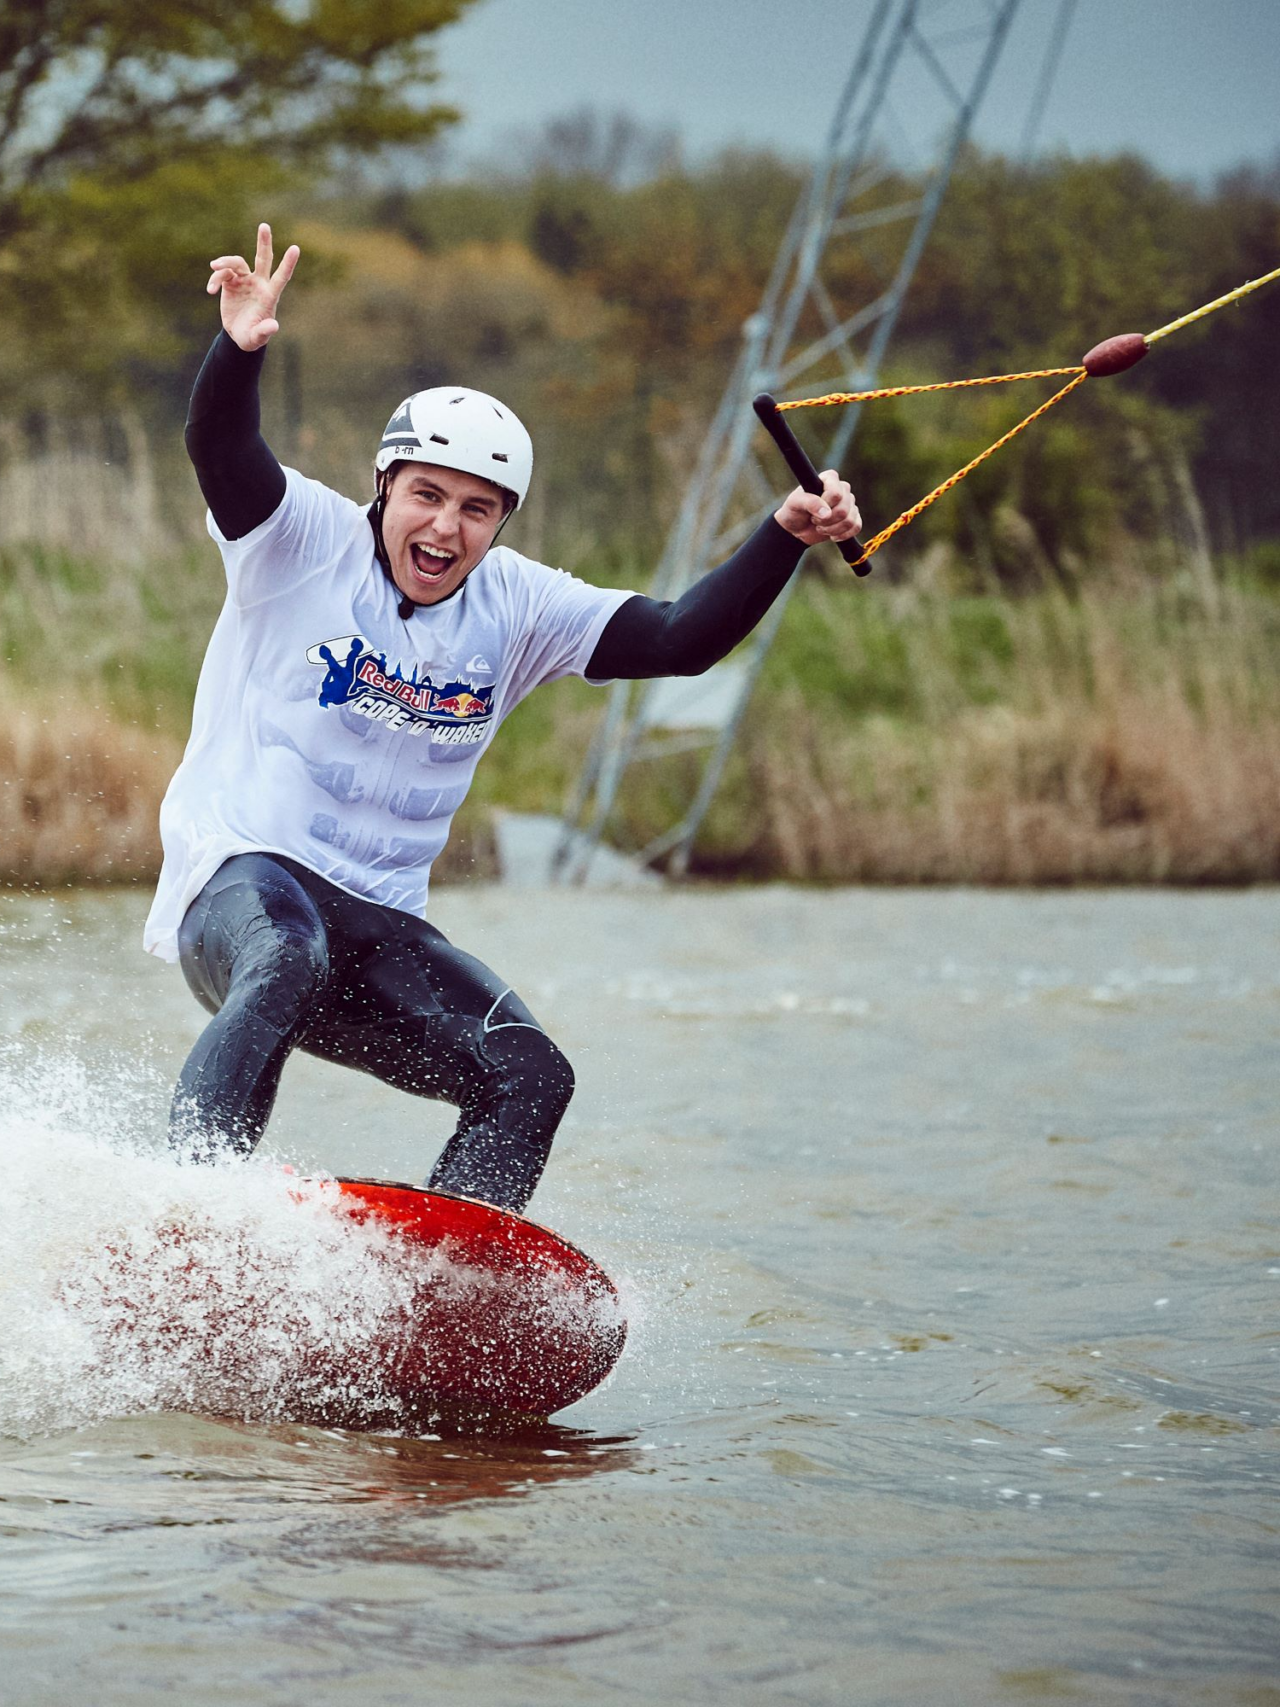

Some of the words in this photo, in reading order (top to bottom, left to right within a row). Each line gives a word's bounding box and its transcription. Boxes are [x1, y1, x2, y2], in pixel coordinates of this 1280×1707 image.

[358, 660, 402, 694] Red
[395, 684, 431, 711] Bull
[352, 696, 411, 731] COPE
